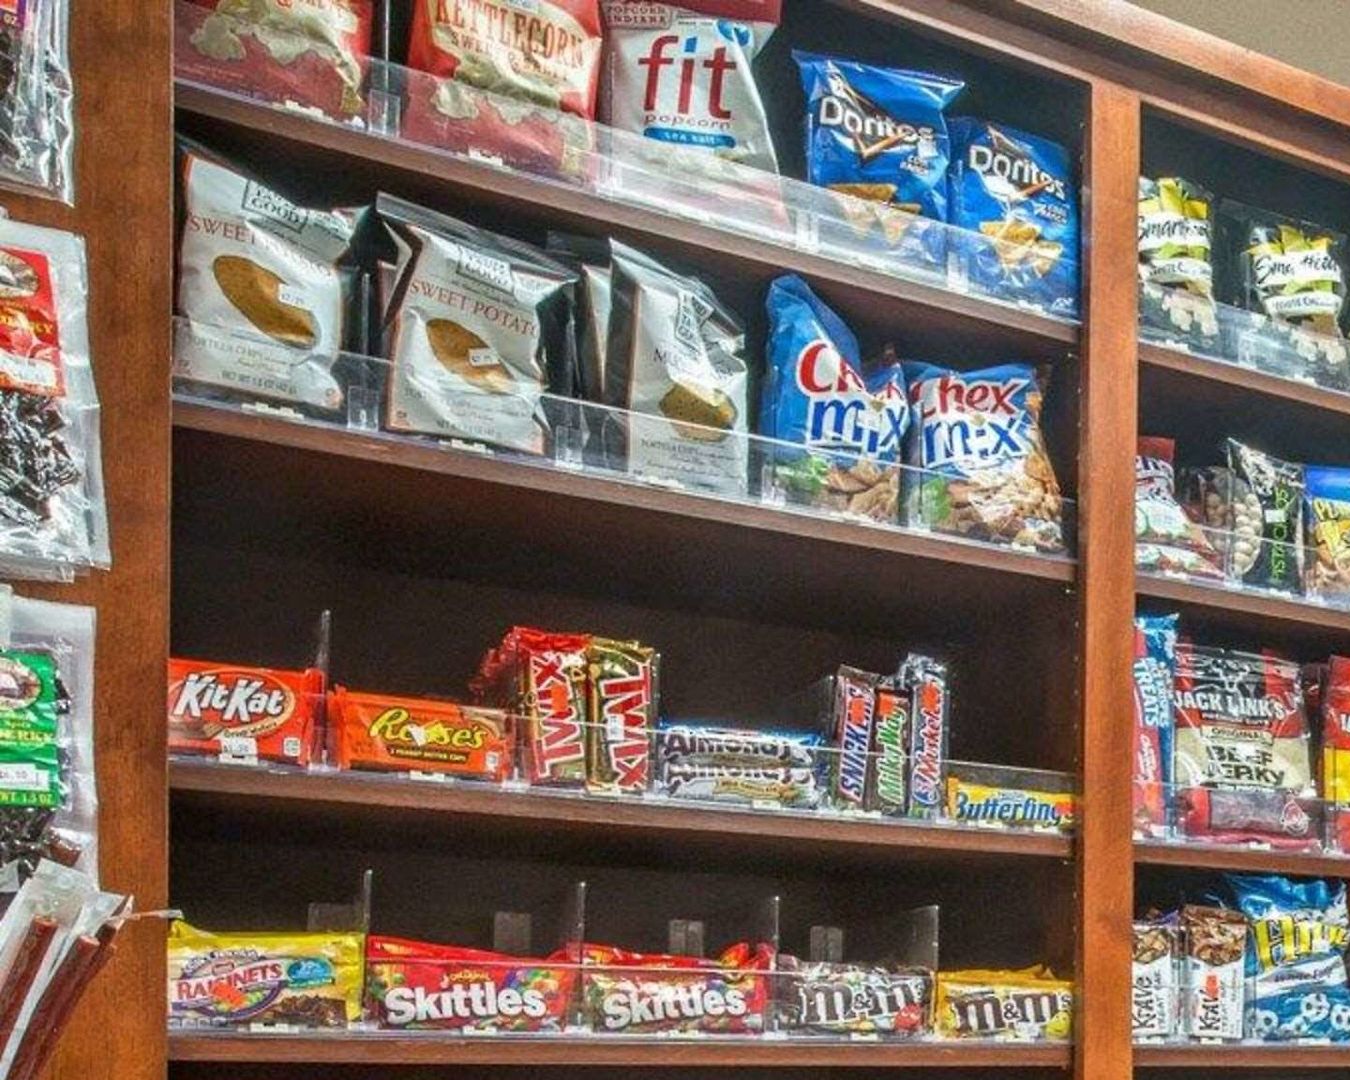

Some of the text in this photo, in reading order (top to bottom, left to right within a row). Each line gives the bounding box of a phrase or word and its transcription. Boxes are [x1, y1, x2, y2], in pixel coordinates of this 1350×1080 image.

[436, 0, 585, 68] KETTLECORN
[608, 15, 668, 26] INDIANA
[638, 35, 737, 119] fit
[644, 114, 732, 130] popcorn
[819, 95, 934, 146] Doritos
[969, 145, 1066, 200] Doritos
[188, 215, 256, 245] SWEET
[411, 278, 468, 311] SWEET
[907, 375, 1029, 419] Chex
[530, 652, 584, 778] TWIX
[602, 661, 650, 789] TWIX
[1175, 690, 1223, 711] JACK
[1227, 693, 1286, 720] LINK'S
[385, 980, 548, 1025] Skittles
[603, 980, 748, 1030] Skittles
